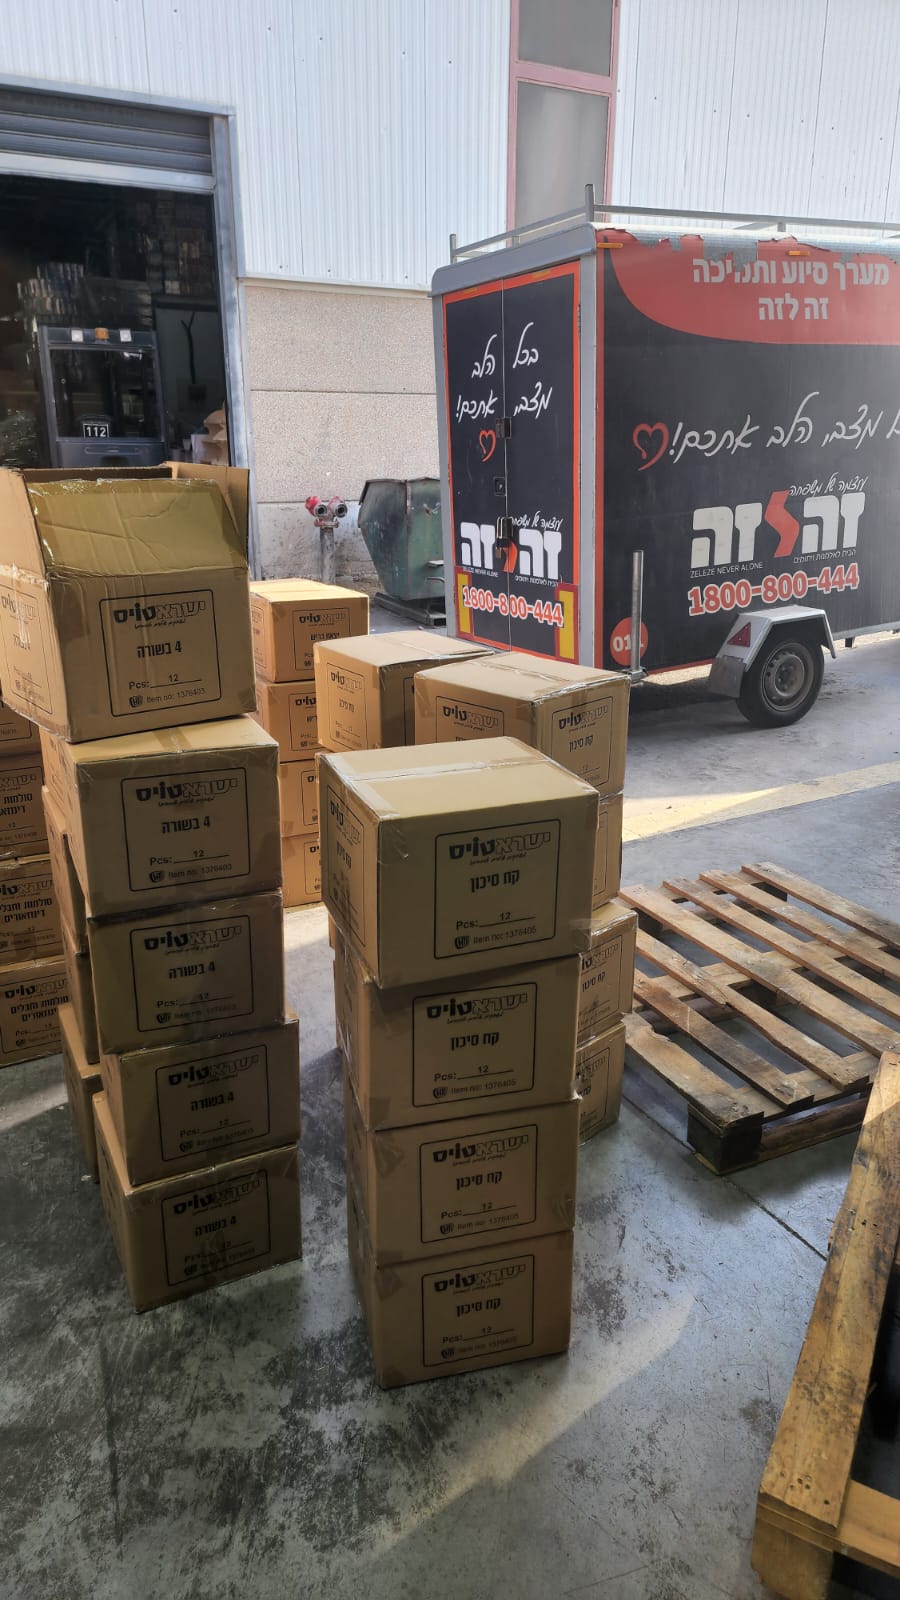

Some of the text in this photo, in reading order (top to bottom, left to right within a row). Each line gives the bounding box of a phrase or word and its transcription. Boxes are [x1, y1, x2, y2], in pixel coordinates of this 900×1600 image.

[782, 261, 827, 285] סיוע
[832, 262, 889, 290] מערך
[758, 292, 829, 320] זה לזה
[512, 322, 539, 368] בכל
[471, 334, 497, 378] הלב
[456, 389, 498, 423] אתכם!
[765, 391, 820, 448] הלב
[86, 426, 106, 438] 112
[668, 414, 760, 464] אתכם!
[823, 471, 839, 494] של
[690, 561, 764, 579] ZELEZE NEVER ALONE
[687, 562, 859, 617] 1800-800-444
[463, 586, 564, 628] 1800-800-444
[137, 640, 182, 658] 4 בשורה
[129, 674, 179, 690] Pcs: 12
[162, 816, 211, 834] 4 בשורה
[470, 869, 520, 893] קח סיכון
[500, 912, 511, 921] 12
[168, 961, 216, 979] 4 בשורה
[450, 1032, 500, 1051] קח סיכון
[478, 1065, 489, 1073] 12
[190, 1094, 225, 1111] בשורה
[456, 1171, 502, 1191] קח סיכון
[482, 1202, 493, 1210] 12
[456, 1298, 501, 1317] קח סיכון
[482, 1326, 492, 1334] 12
